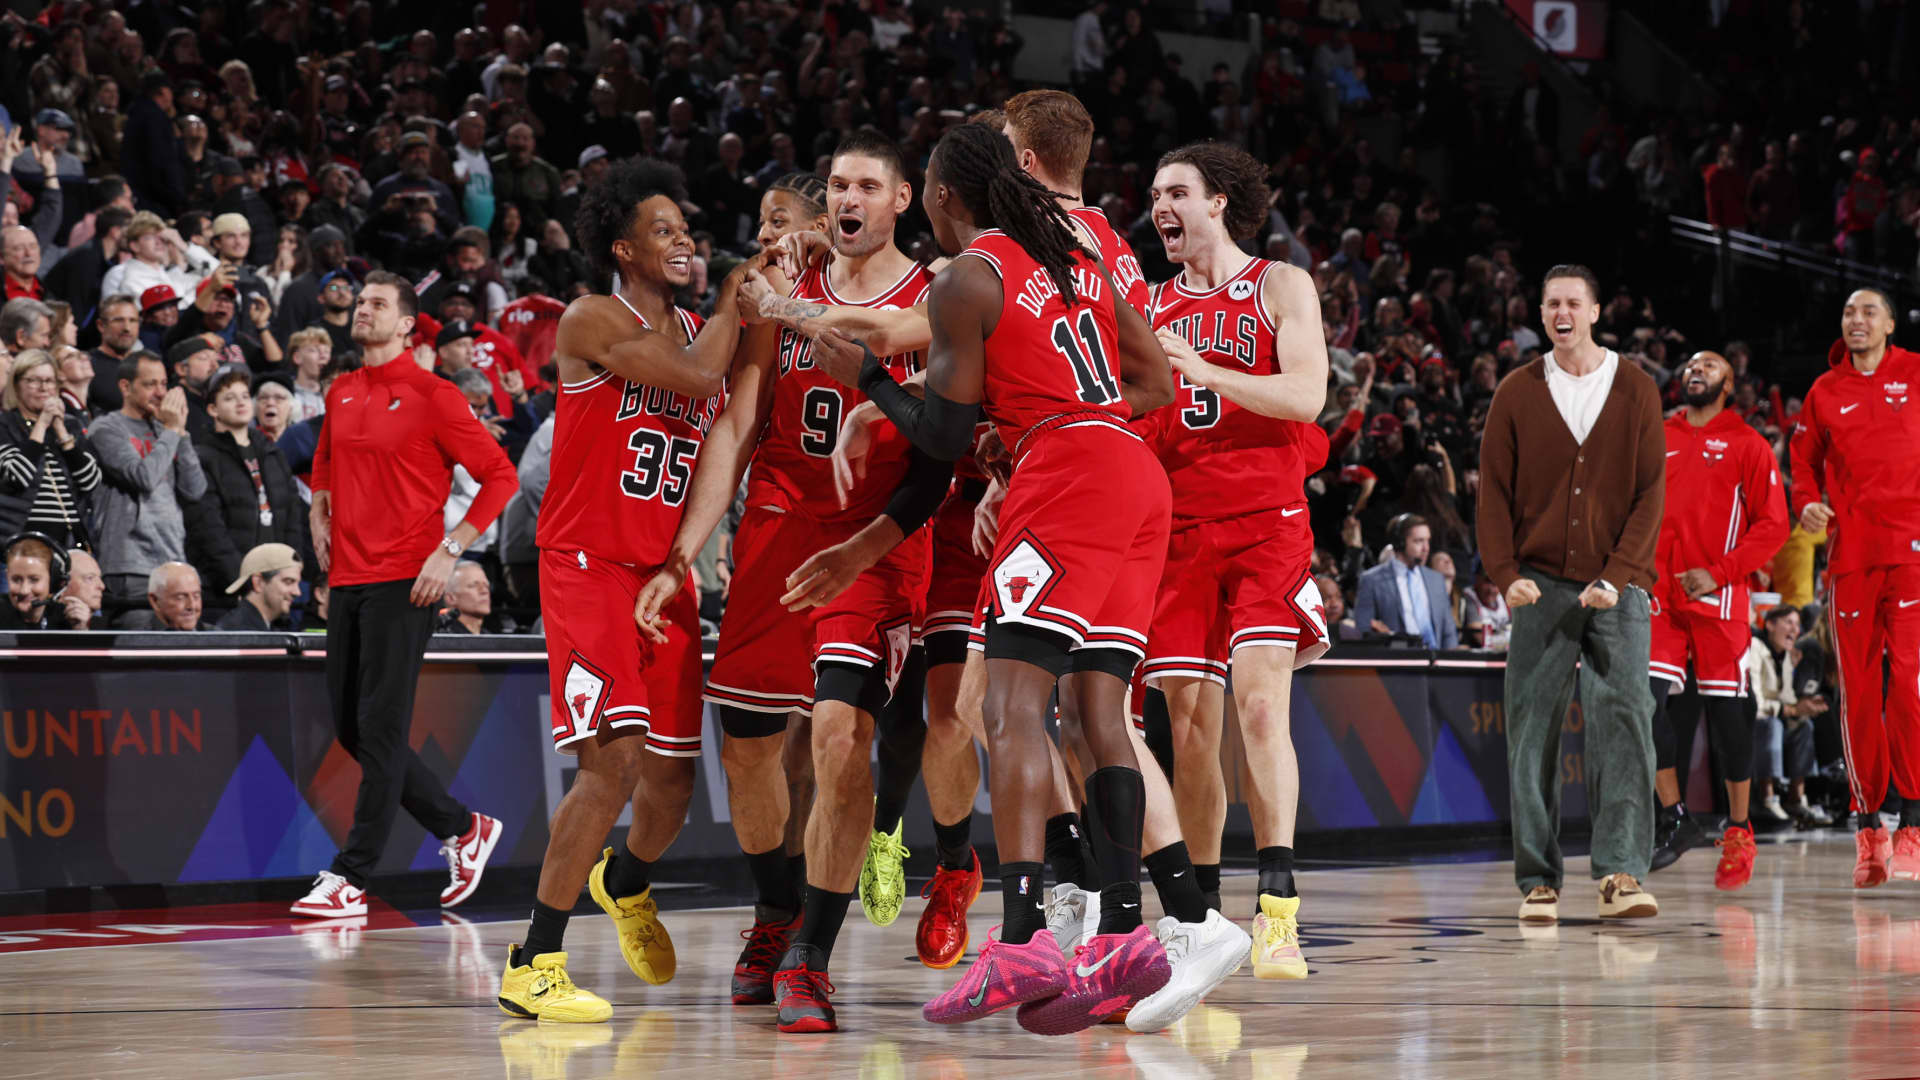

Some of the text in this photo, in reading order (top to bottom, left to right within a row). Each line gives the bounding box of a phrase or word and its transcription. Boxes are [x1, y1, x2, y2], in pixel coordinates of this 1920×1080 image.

[1016, 267, 1101, 318] DOSUMU
[1051, 308, 1122, 405] 11
[1170, 310, 1257, 367] ULLS
[801, 386, 842, 458] 9
[1180, 373, 1222, 430] 3
[620, 427, 700, 507] 35
